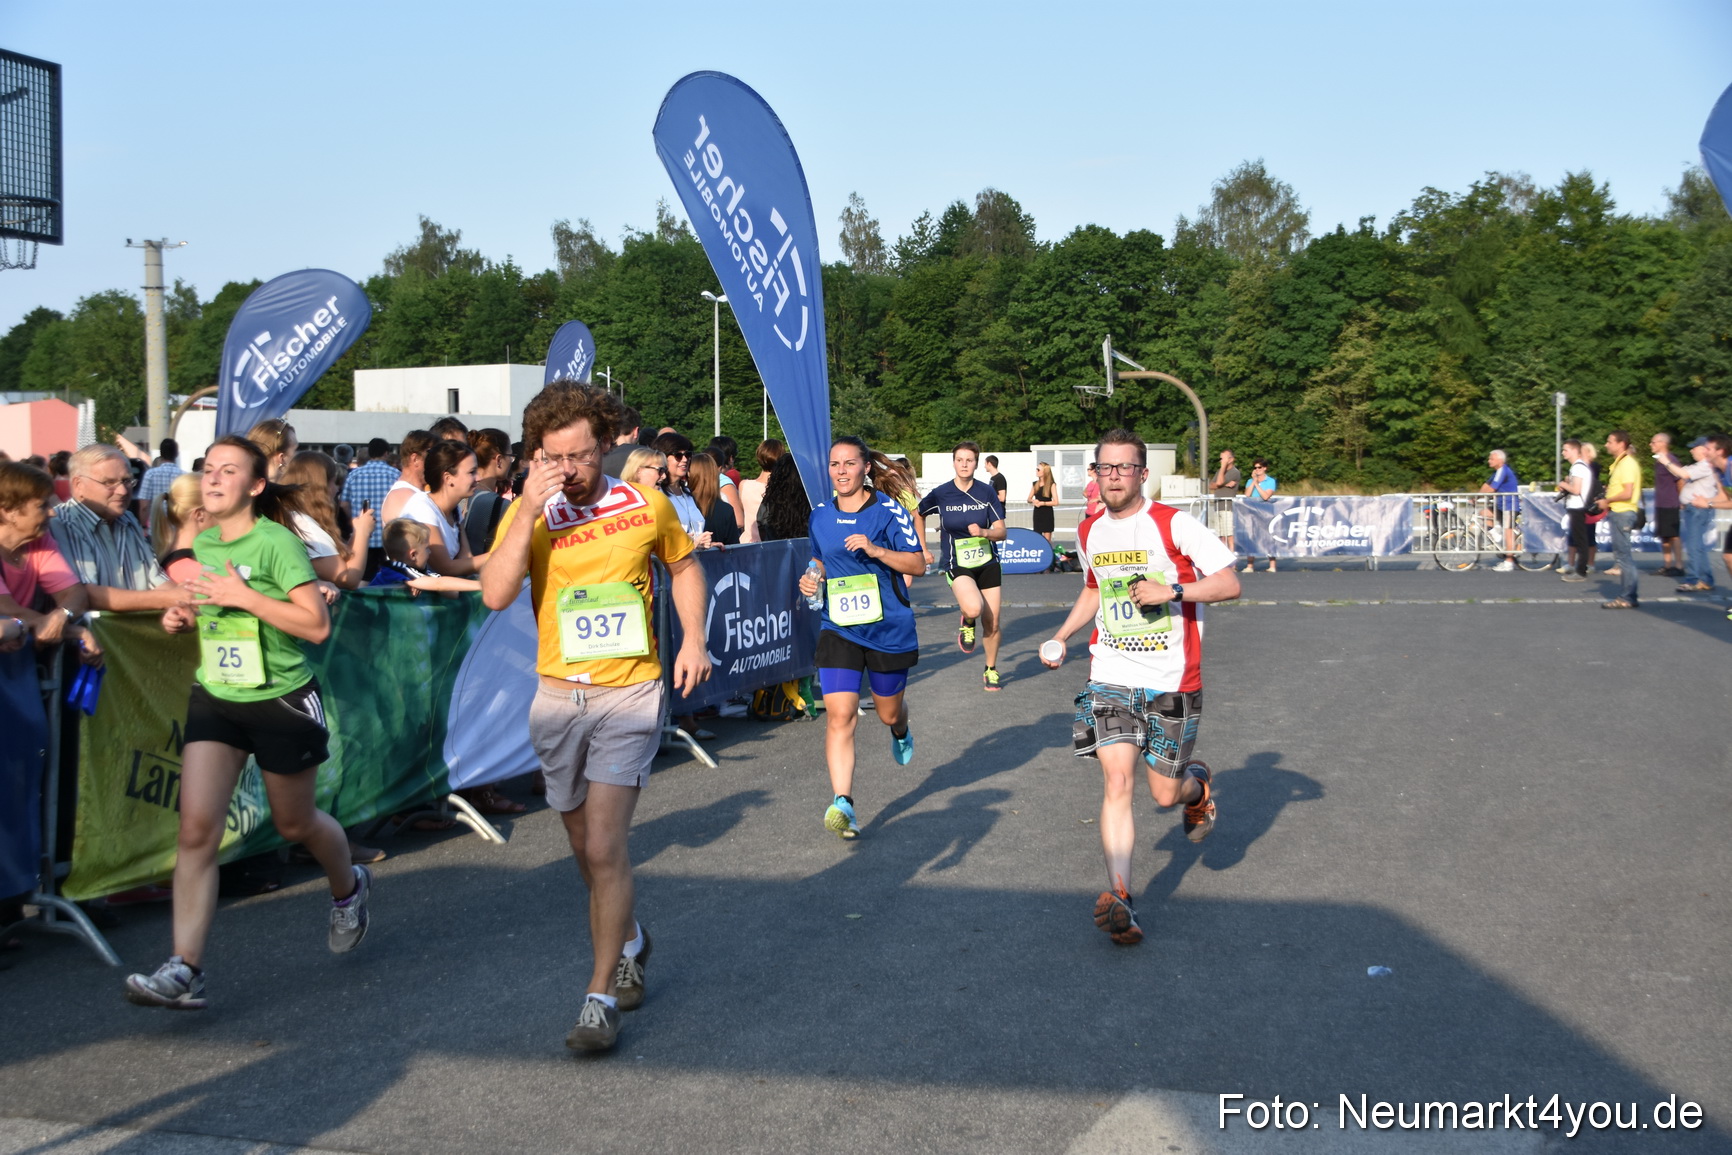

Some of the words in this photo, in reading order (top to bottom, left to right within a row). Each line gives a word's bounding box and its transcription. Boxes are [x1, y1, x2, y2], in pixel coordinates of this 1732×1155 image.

[252, 295, 338, 393] Fischer
[277, 316, 348, 393] AUTOMOBILE
[551, 528, 598, 551] MAX
[602, 513, 654, 536] BÖGL
[1287, 520, 1376, 539] Fischer
[963, 547, 985, 561] 375
[1295, 539, 1368, 548] AUTOMOBILE
[1094, 552, 1142, 566] ONLINE
[840, 594, 870, 612] 819
[575, 612, 627, 640] 937
[217, 646, 243, 668] 25
[729, 644, 792, 676] AUTOMOBILE
